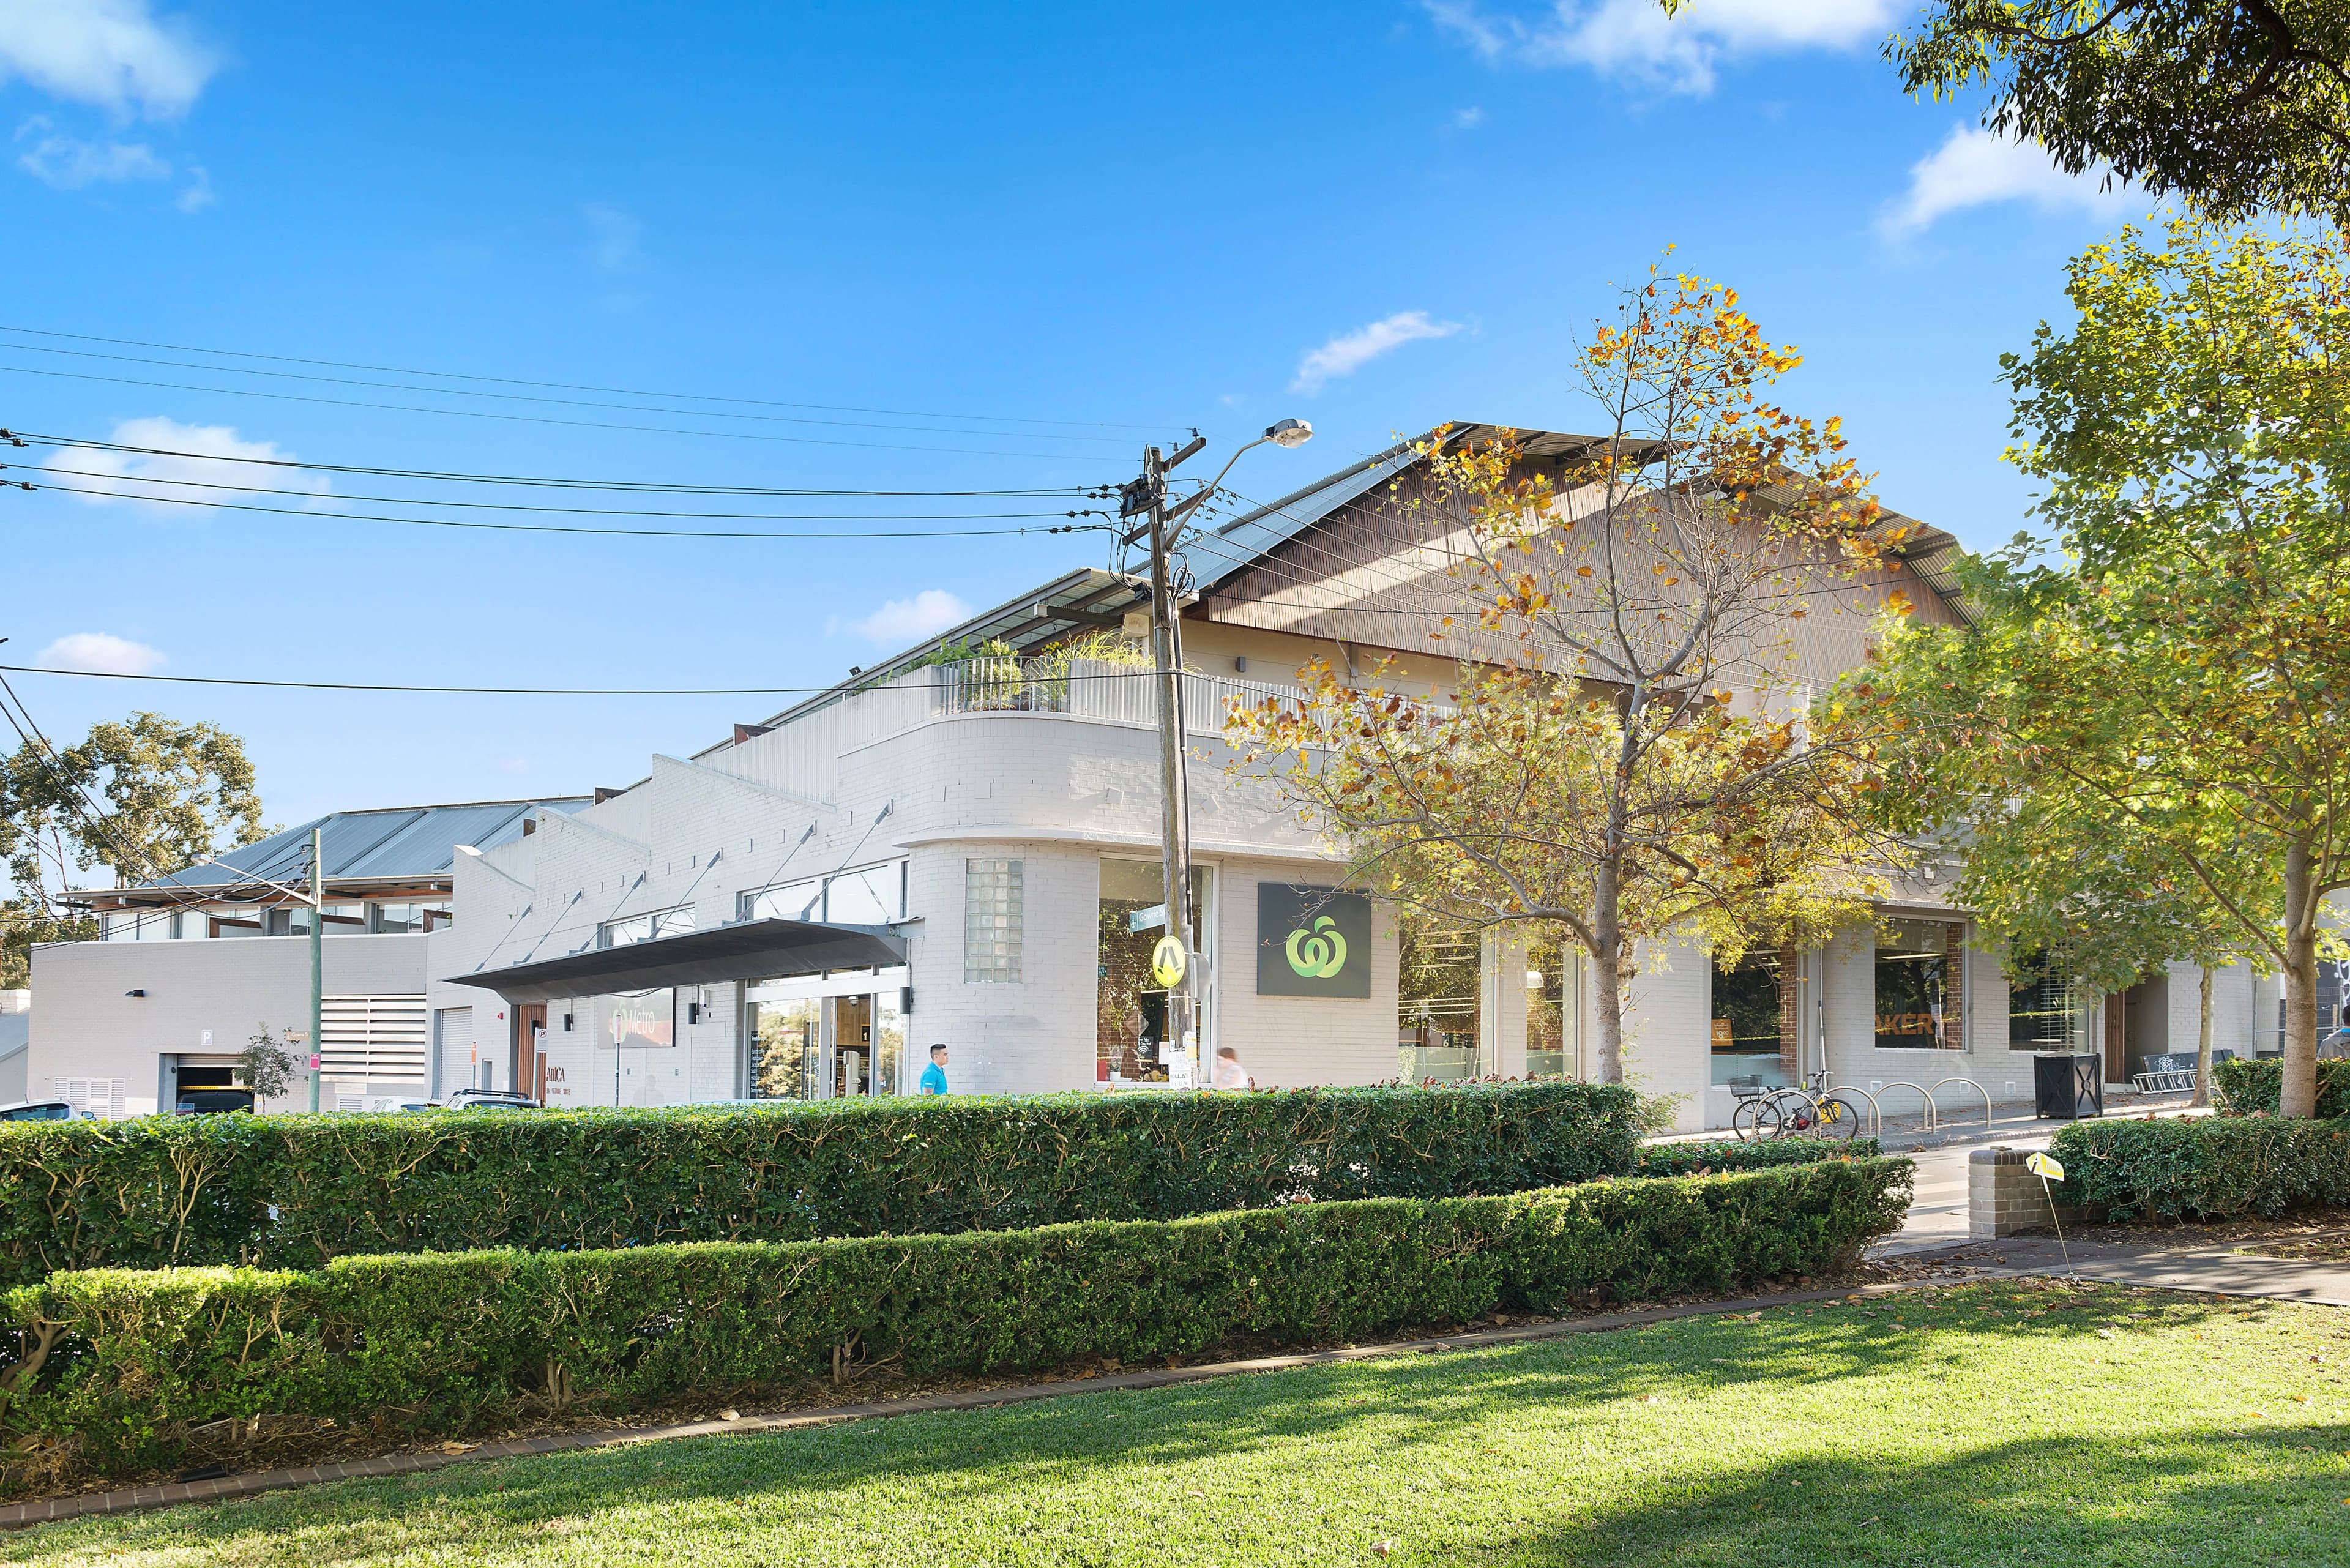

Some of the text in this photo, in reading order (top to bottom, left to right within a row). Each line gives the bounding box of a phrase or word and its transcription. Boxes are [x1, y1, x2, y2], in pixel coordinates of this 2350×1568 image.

[1139, 911, 1159, 922] Gowrie
[629, 1006, 655, 1034] Metro
[203, 1031, 211, 1044] P
[863, 1032, 867, 1040] 1
